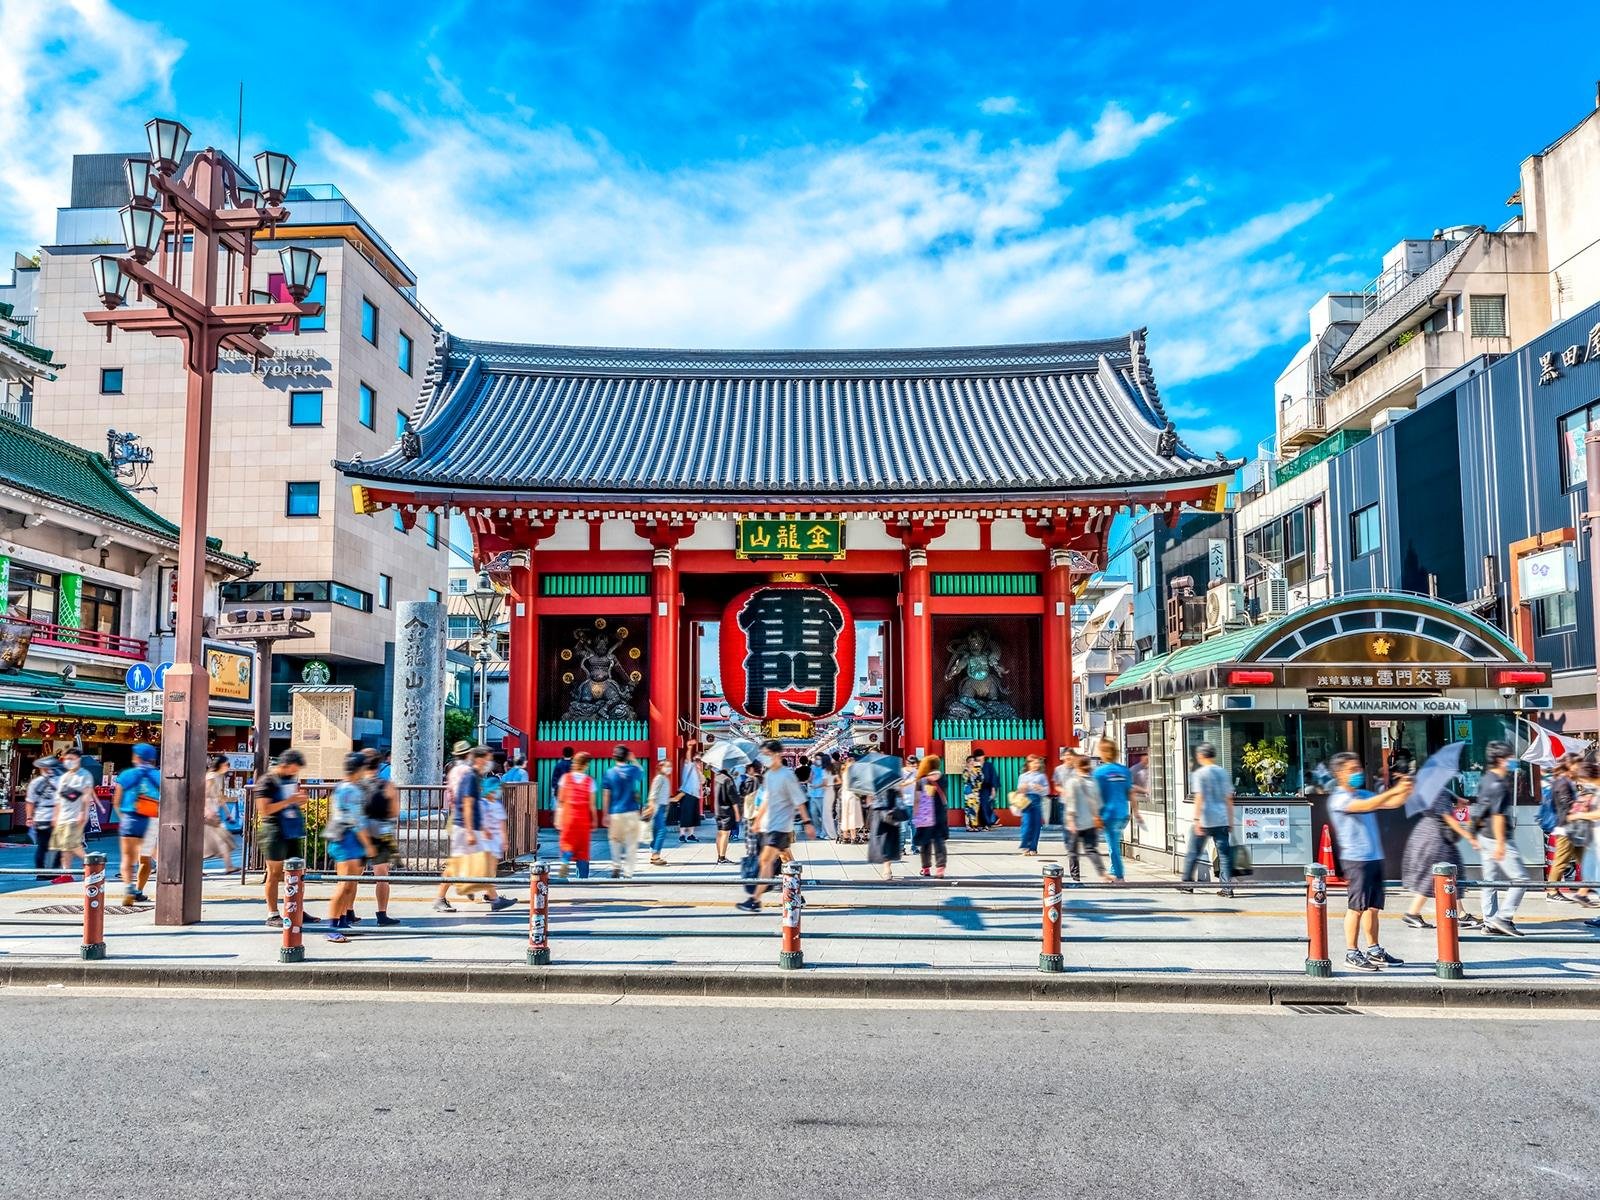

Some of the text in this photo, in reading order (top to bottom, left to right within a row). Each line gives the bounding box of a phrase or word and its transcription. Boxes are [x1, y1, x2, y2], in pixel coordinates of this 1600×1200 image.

[1210, 543, 1224, 578] 天ぷら
[736, 586, 845, 718] 雷門
[1376, 669, 1452, 686] 雷門交番
[1338, 701, 1461, 711] KAMINARIMON KOBAN
